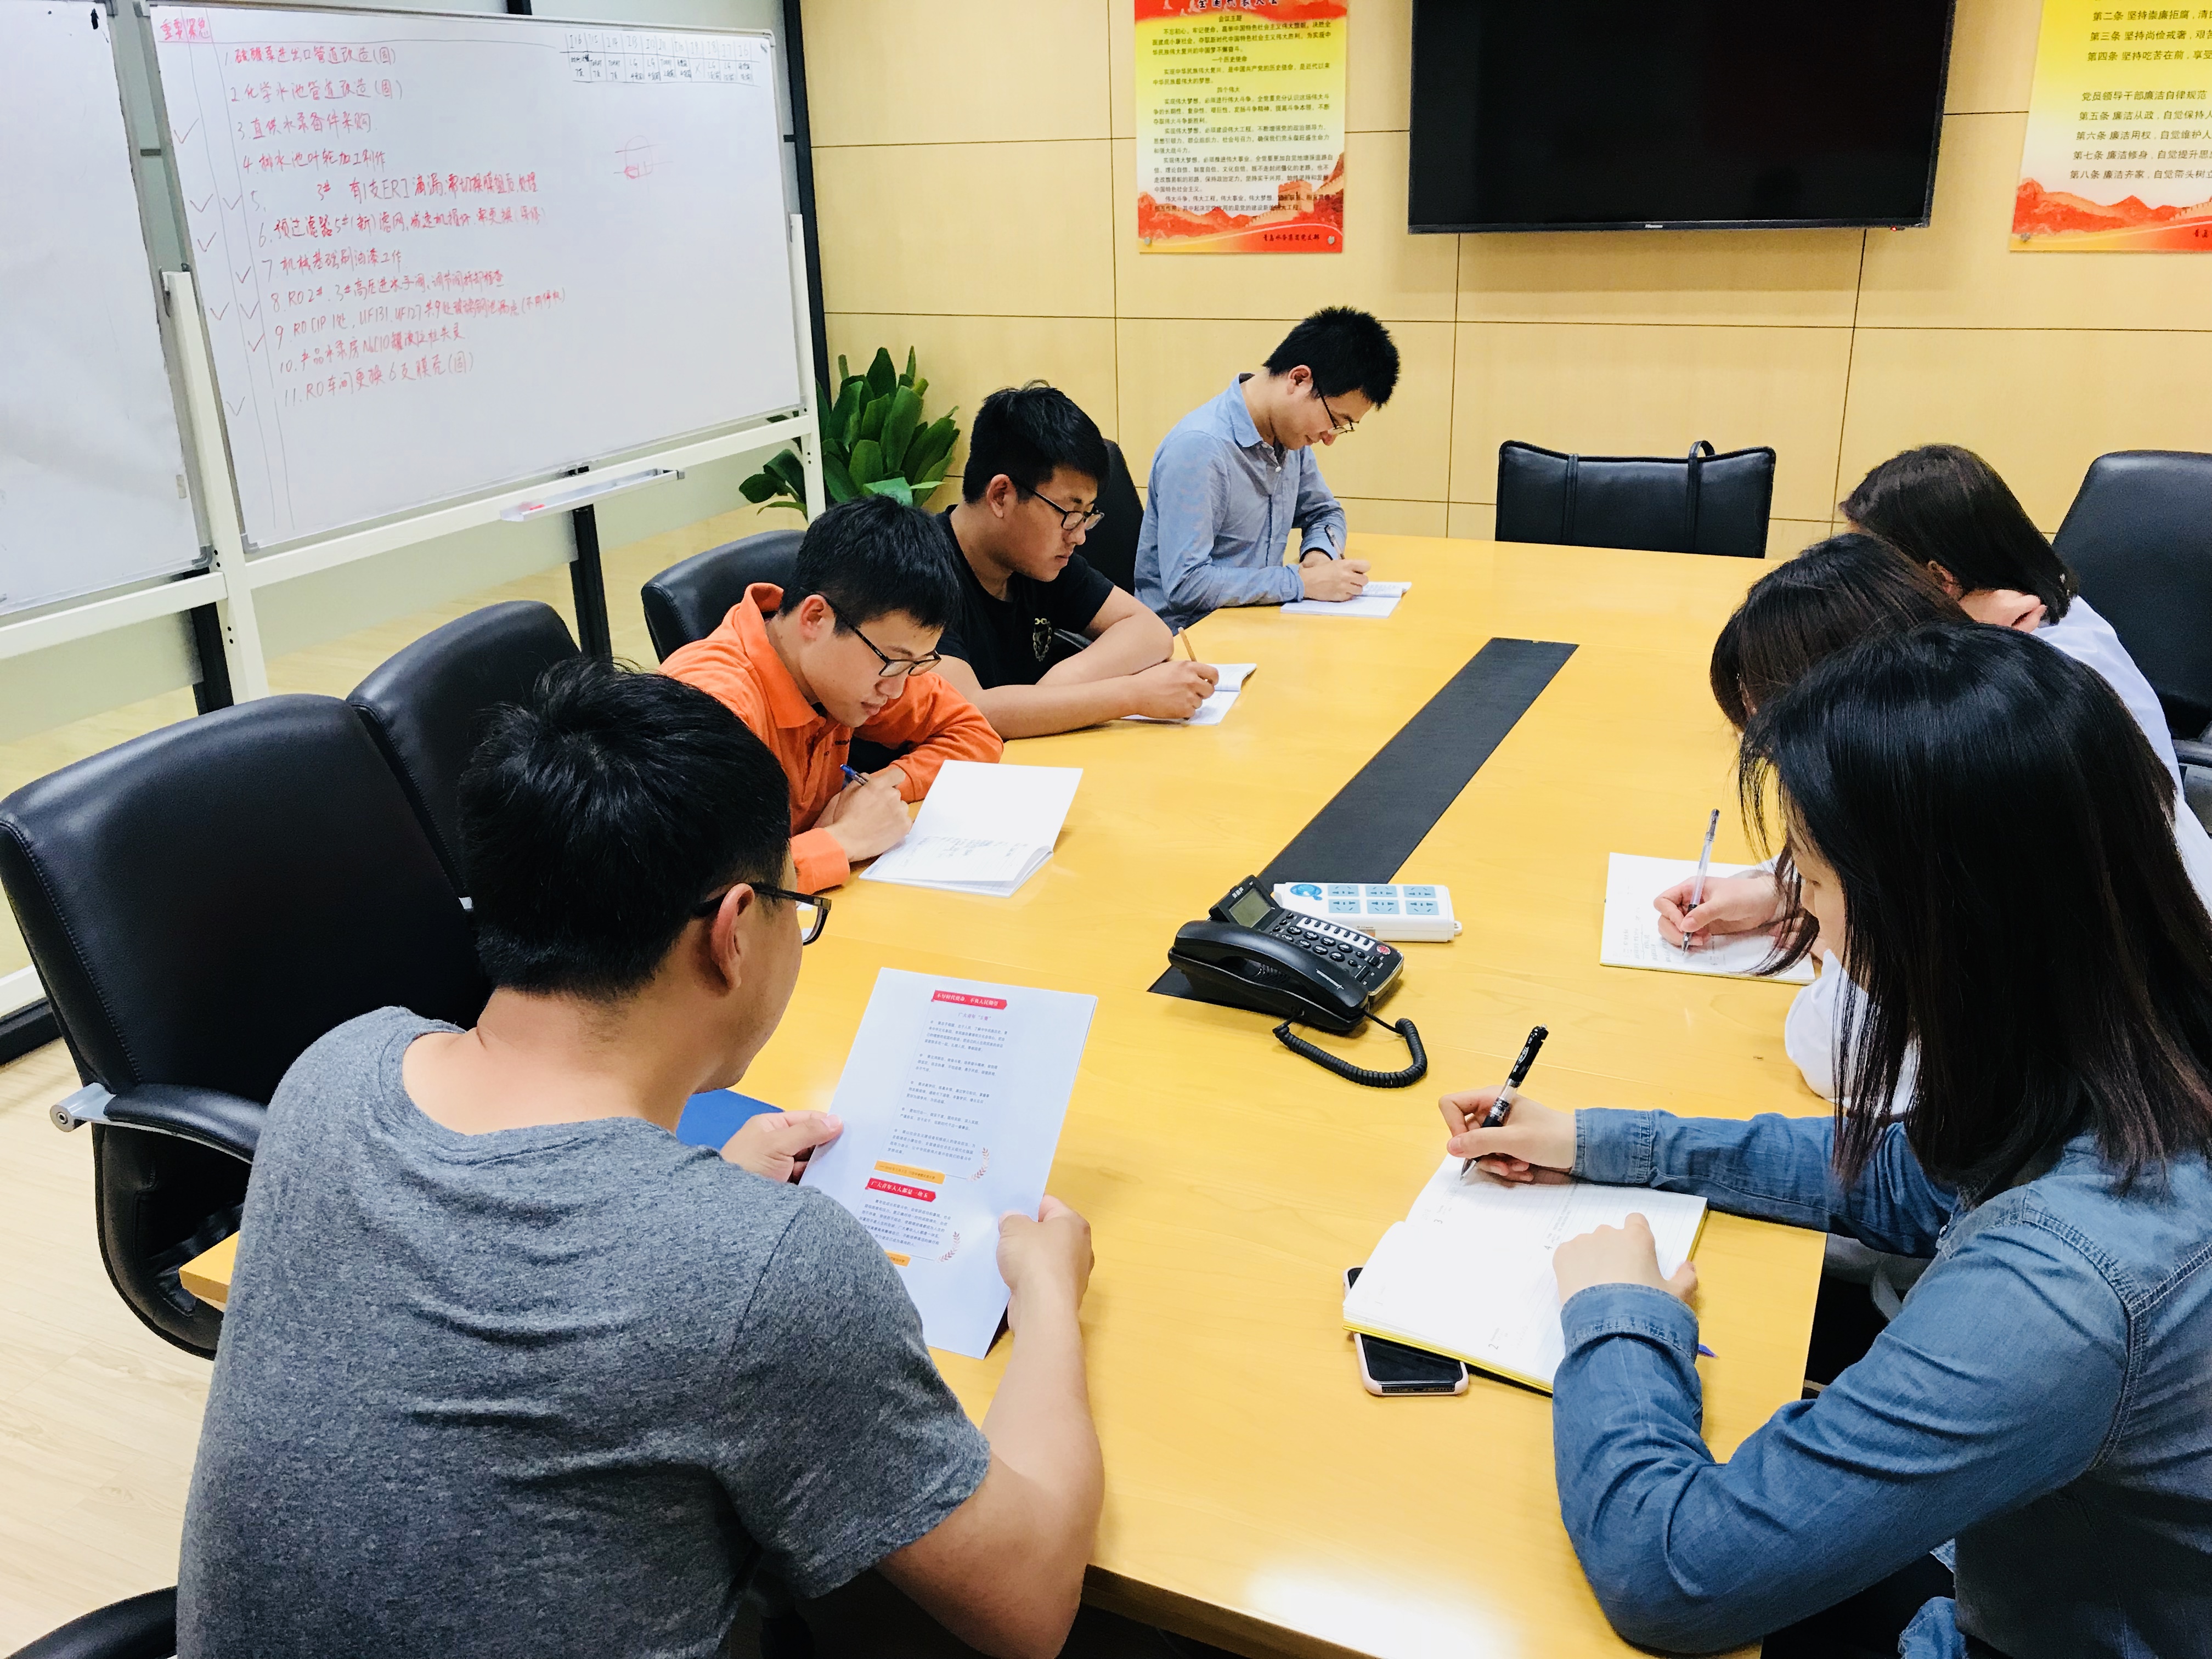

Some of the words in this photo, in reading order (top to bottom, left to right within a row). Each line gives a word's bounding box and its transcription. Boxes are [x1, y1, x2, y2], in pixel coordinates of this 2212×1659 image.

[2092, 11, 2124, 21] 第二条
[160, 19, 183, 40] 重要
[186, 17, 210, 39] 紧急
[2090, 31, 2120, 41] 第三条
[2087, 52, 2118, 61] 第四条
[2081, 90, 2207, 101] 党员领导干部廉洁自律规范
[2079, 111, 2109, 121] 第五条
[2076, 131, 2106, 141] 第六条
[2073, 151, 2103, 160] 第七条
[2070, 170, 2100, 179] 第八条
